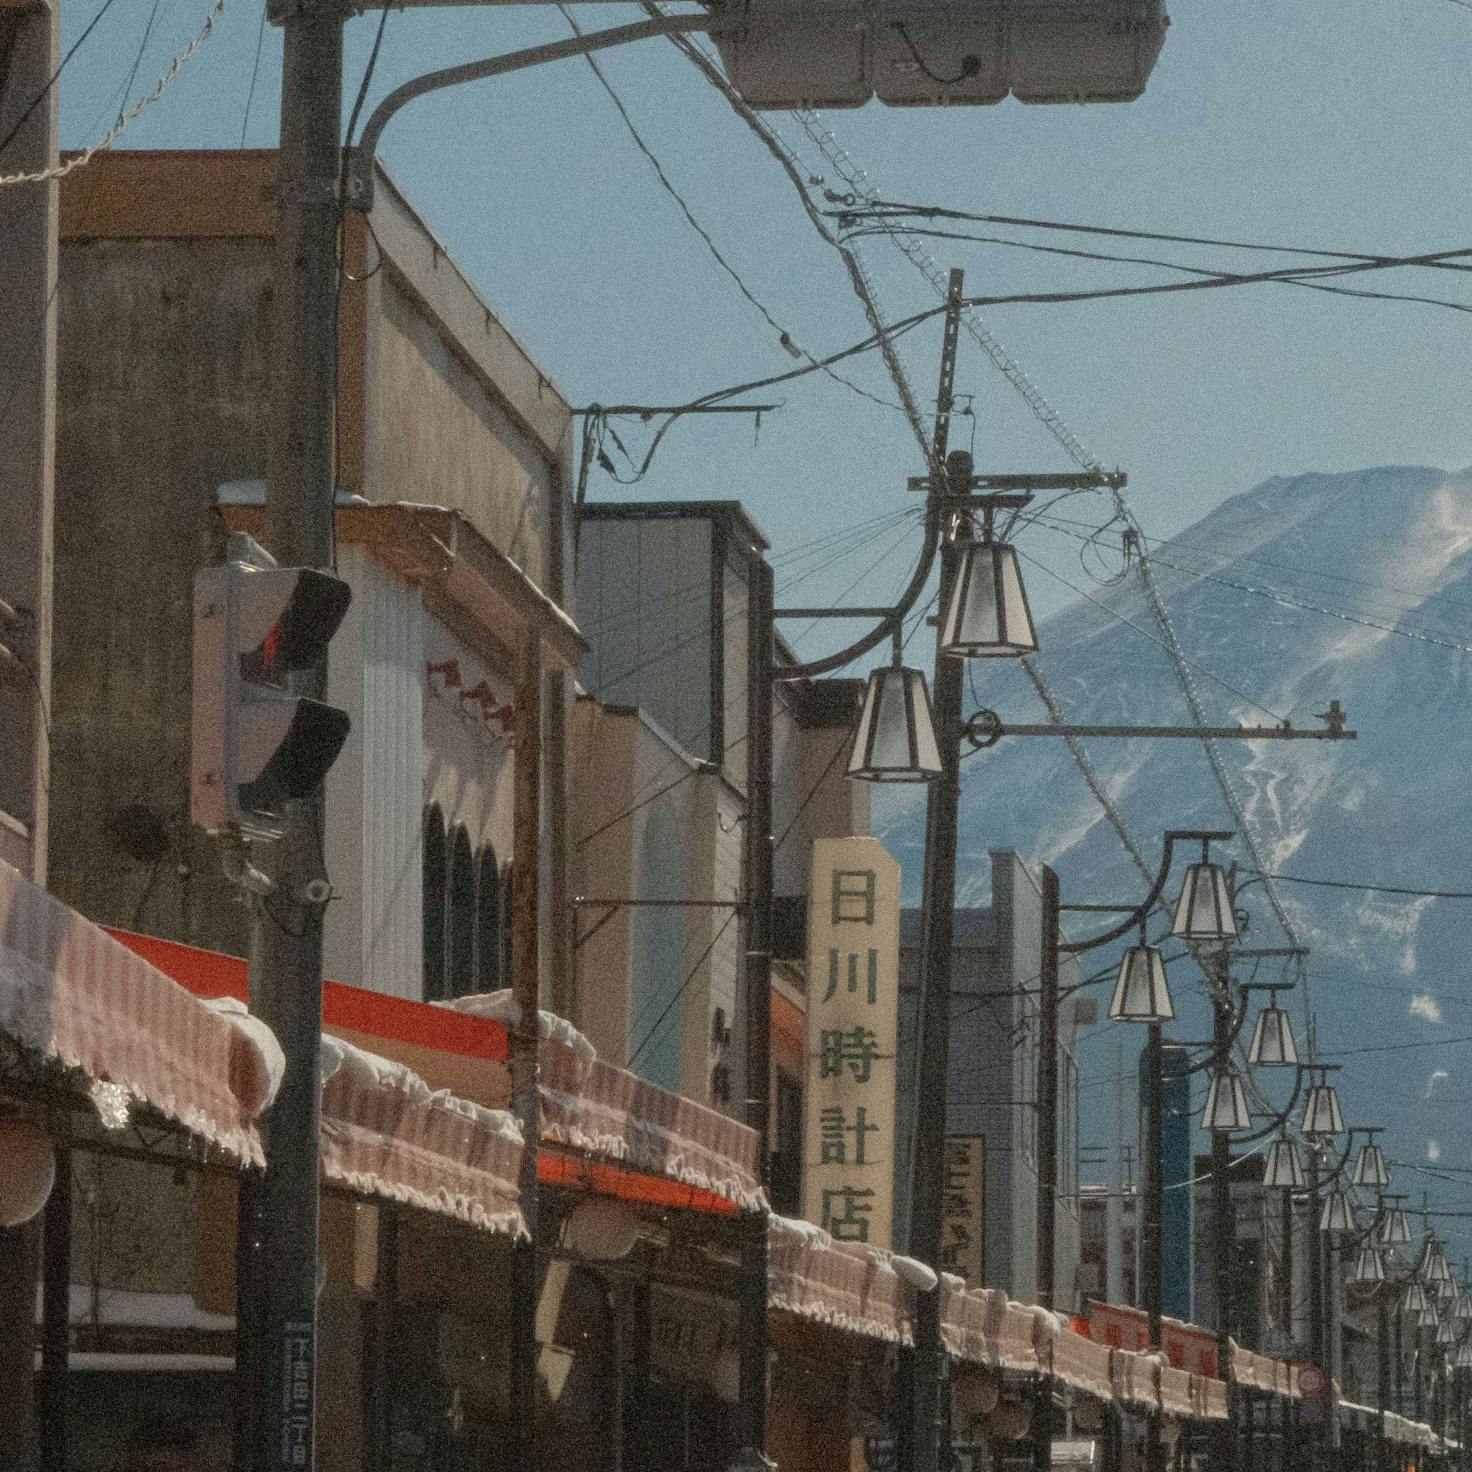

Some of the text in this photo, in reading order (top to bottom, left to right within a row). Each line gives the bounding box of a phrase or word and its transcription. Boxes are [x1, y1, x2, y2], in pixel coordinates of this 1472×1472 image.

[820, 867, 879, 1242] 日川時計店
